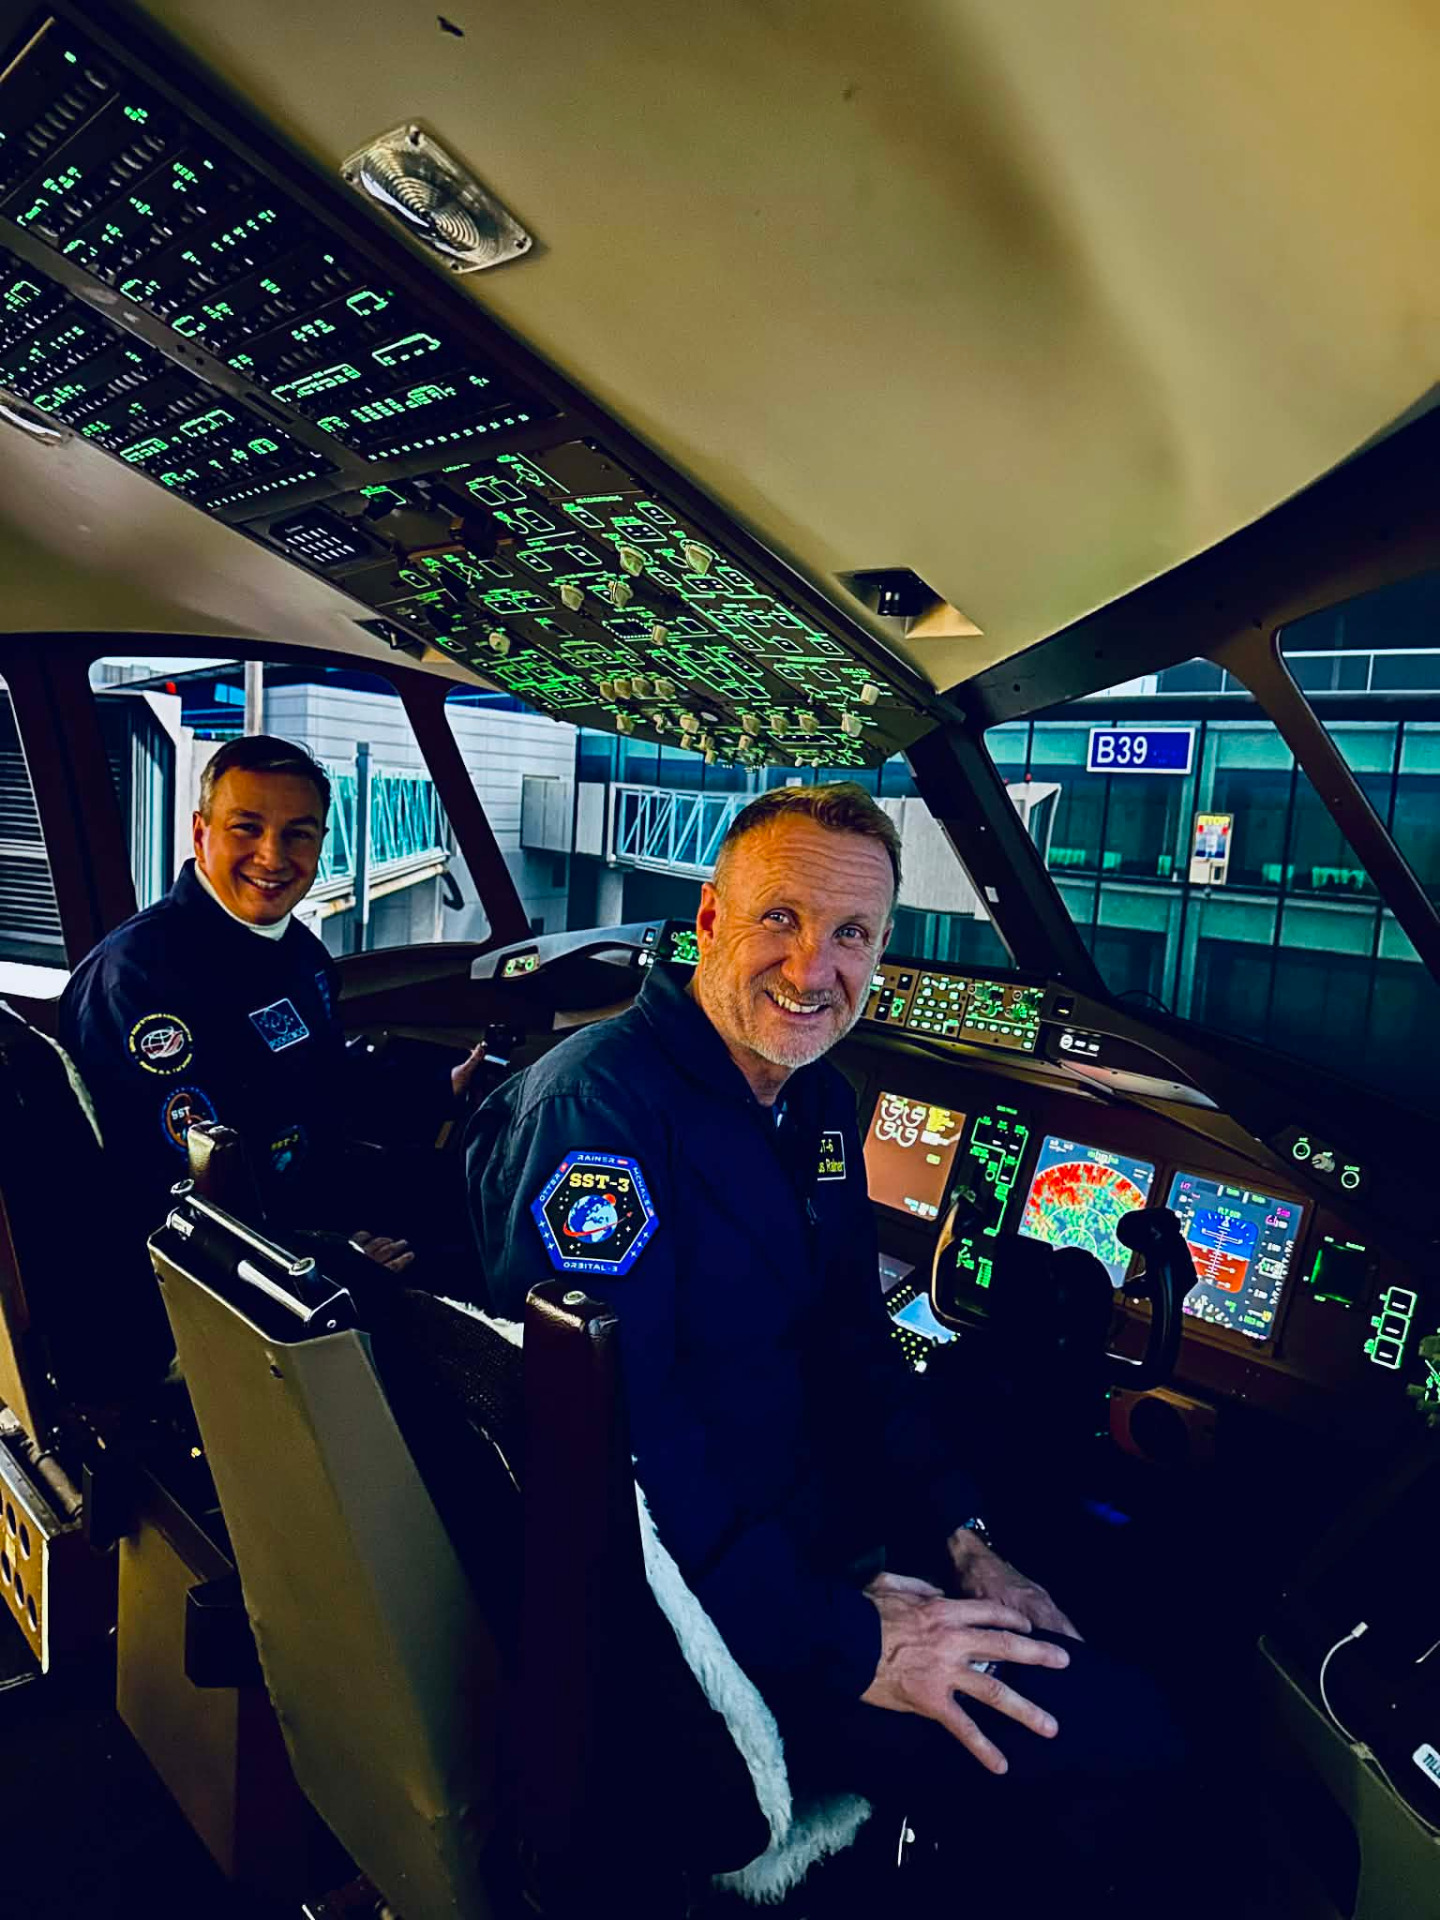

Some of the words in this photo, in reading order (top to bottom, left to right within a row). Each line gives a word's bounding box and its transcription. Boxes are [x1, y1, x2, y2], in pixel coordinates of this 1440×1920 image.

[1096, 735, 1148, 765] B39
[171, 1106, 191, 1120] SST
[576, 1154, 616, 1164] RAINER
[569, 1172, 630, 1193] SST-3
[563, 1261, 619, 1272] ORBITAL-3
